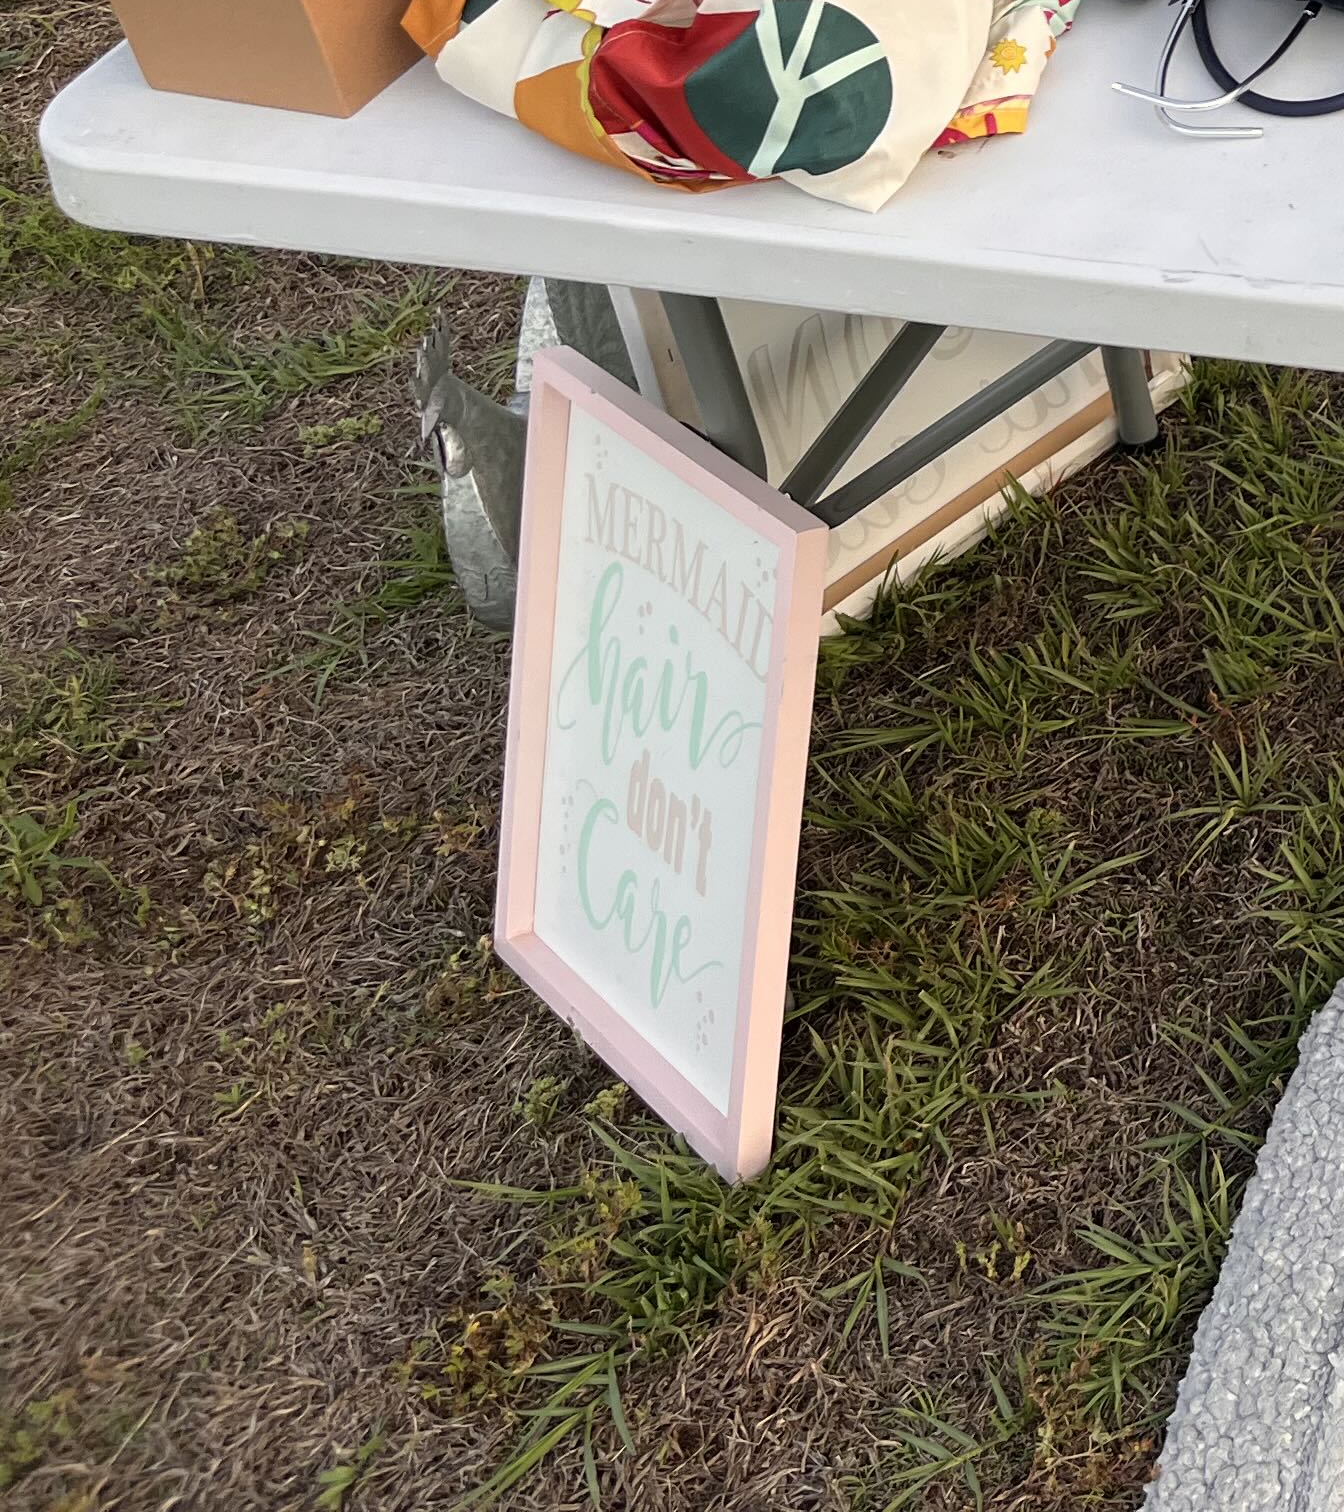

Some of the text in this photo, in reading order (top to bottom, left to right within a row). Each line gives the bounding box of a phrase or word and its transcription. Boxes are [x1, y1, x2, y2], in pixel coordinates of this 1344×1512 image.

[556, 561, 764, 769] hair
[584, 471, 773, 684] MERMAID
[576, 778, 724, 1009] Care
[626, 748, 713, 898] don't
